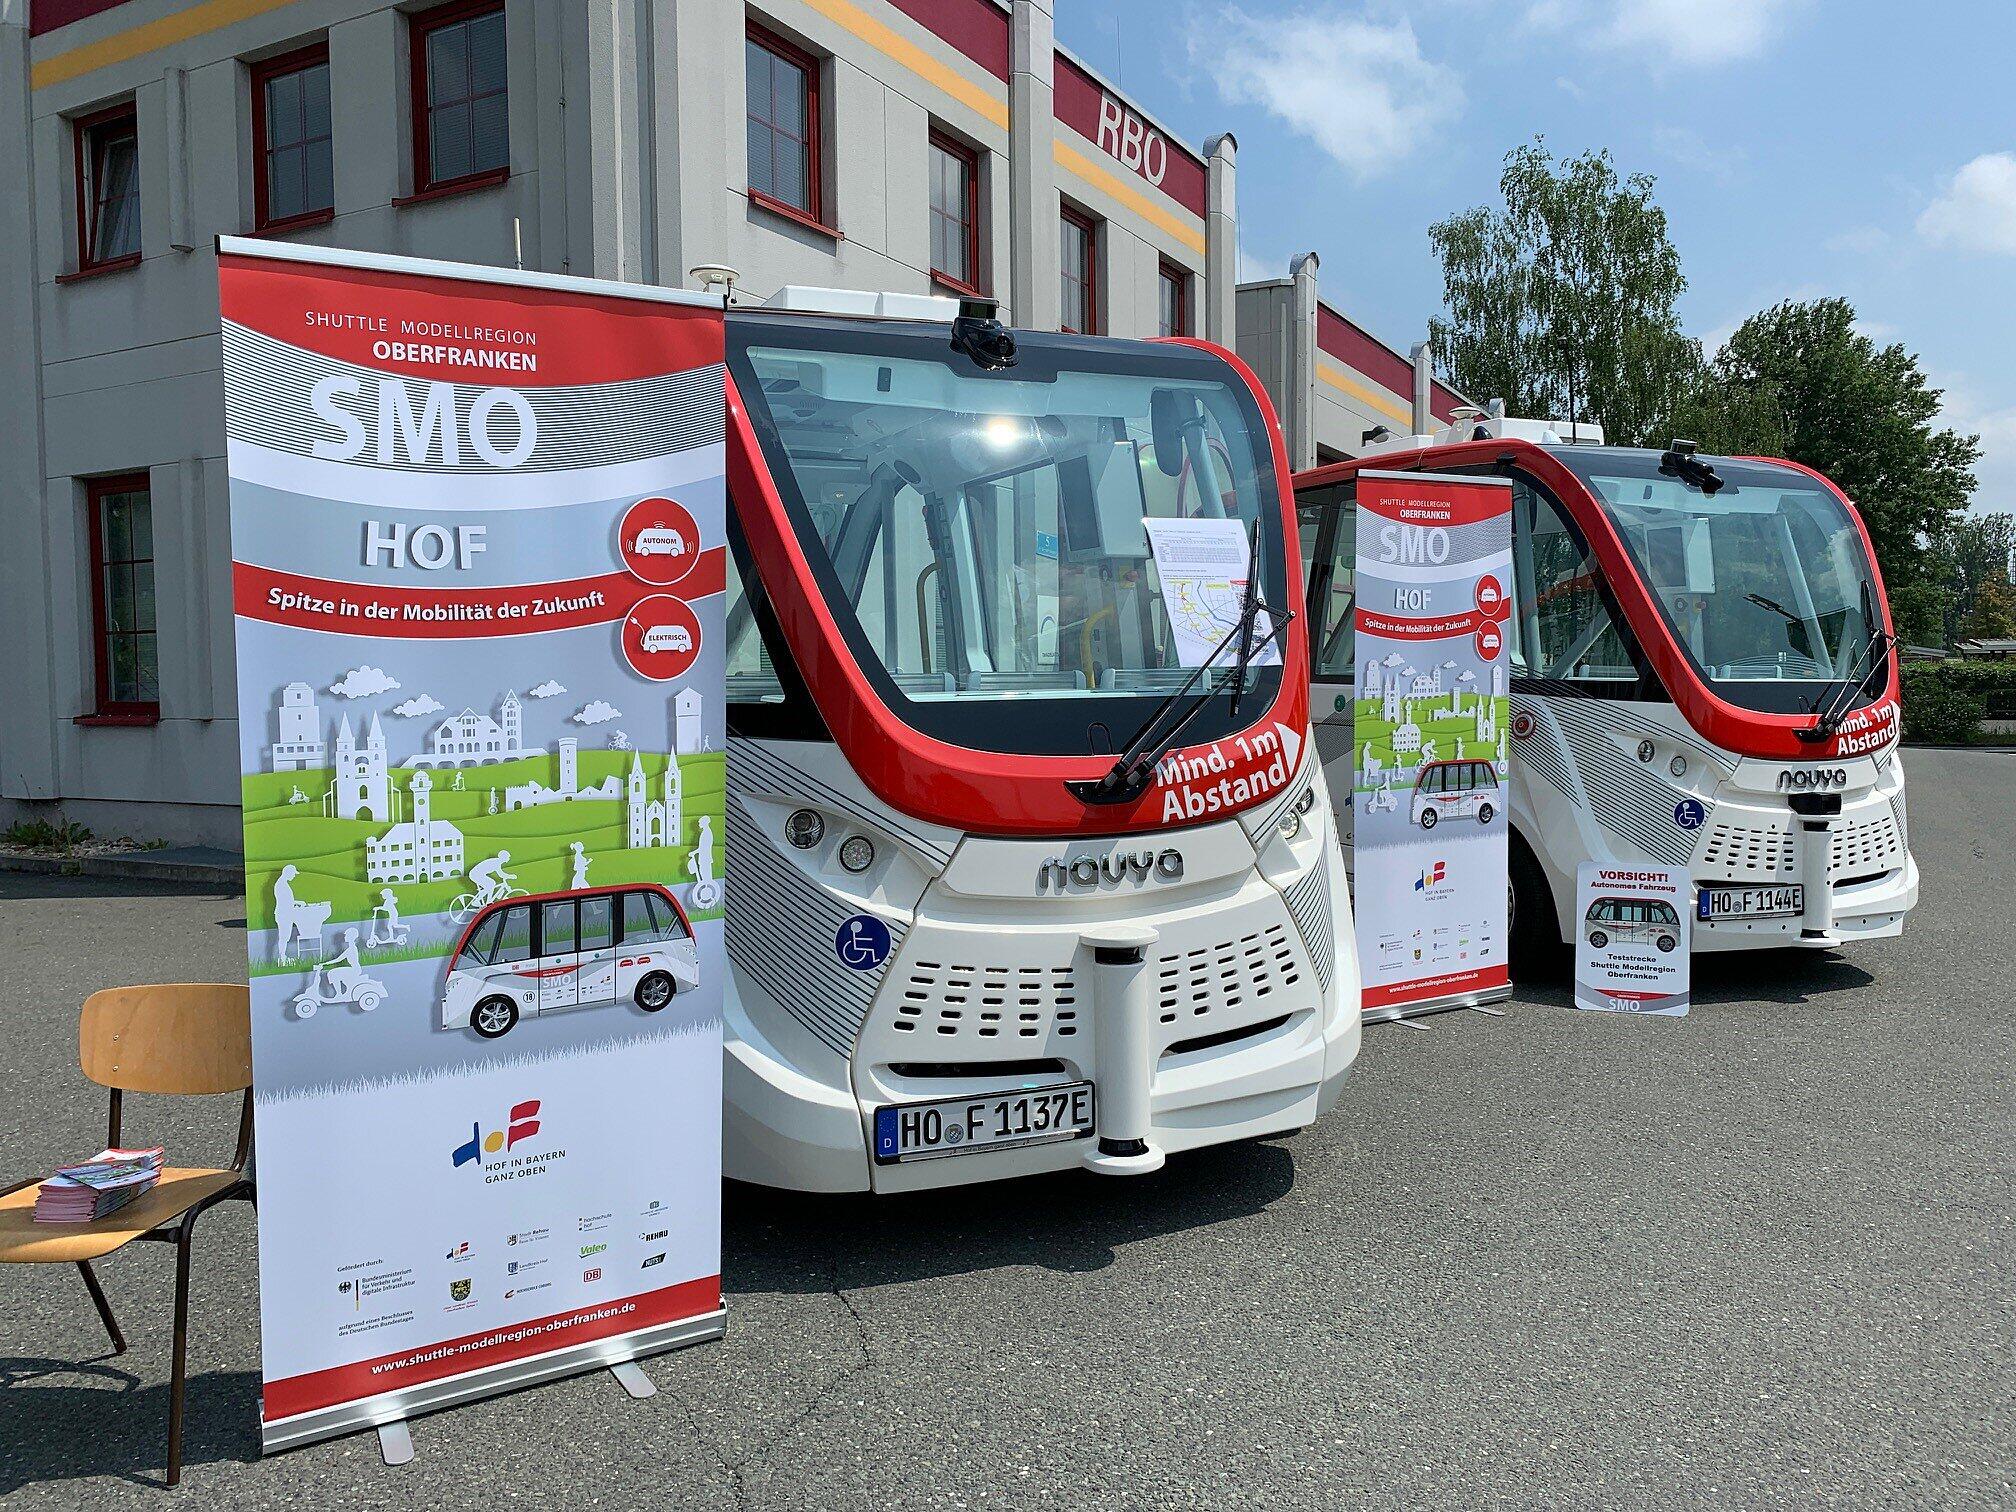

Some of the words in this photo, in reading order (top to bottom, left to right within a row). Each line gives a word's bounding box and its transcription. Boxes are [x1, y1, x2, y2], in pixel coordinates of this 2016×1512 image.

[1096, 89, 1166, 187] RBO
[305, 311, 388, 332] SHUTTLE
[401, 320, 537, 346] MODELLREGION
[372, 340, 537, 372] OBERFRANKEN
[310, 375, 538, 468] SMO
[1380, 498, 1405, 506] SHUTTLE
[1408, 500, 1451, 508] MODELLREGION
[1400, 509, 1451, 519] OBERFRANKEN
[364, 520, 487, 570] HOF
[642, 537, 677, 545] AUTONOM
[1380, 525, 1450, 564] SMO
[268, 587, 335, 614] Spitze
[339, 598, 359, 617] in
[364, 600, 399, 620] der
[403, 603, 494, 622] Mobilität
[497, 602, 528, 618] der
[532, 591, 605, 616] Zukunft
[1395, 588, 1432, 610] HOF
[1365, 618, 1386, 630] Spitze
[1387, 622, 1394, 631] in
[1395, 623, 1405, 632] der
[1406, 624, 1433, 633] Mobilität
[1433, 623, 1444, 632] der
[1445, 619, 1471, 630] Zukunft
[648, 634, 687, 642] ELEKTRISCH
[1871, 705, 1892, 722] 1m
[1837, 717, 1895, 756] Abstand
[1155, 745, 1235, 788] Mind.
[1235, 729, 1279, 764] 1m
[1161, 752, 1286, 823] Abstand
[1599, 870, 1669, 882] VORSICHT!
[1590, 881, 1636, 890] Autonomes
[1638, 884, 1676, 893] Fahrzeug
[1711, 892, 1732, 913] HO
[1743, 892, 1752, 912] F
[1756, 888, 1801, 911] 1144E
[1607, 954, 1657, 963] Teststrecke
[1590, 961, 1620, 969] Shuttle
[1622, 963, 1676, 974] Modellregion
[543, 974, 572, 988] SMO
[1607, 972, 1658, 981] Oberfranken
[1609, 998, 1640, 1012] SMO
[901, 1108, 942, 1148] HO
[967, 1104, 986, 1140] F
[994, 1090, 1090, 1137] 1137E
[884, 1138, 892, 1148] D
[485, 1161, 507, 1172] HOF
[511, 1158, 522, 1168] IN
[526, 1150, 566, 1164] BAYERN
[485, 1172, 515, 1184] GANZ
[518, 1166, 546, 1178] OBEN
[646, 1230, 668, 1242] REHAU
[580, 1243, 607, 1255] Valeo
[586, 1270, 599, 1281] DB
[371, 1302, 636, 1375] www.shuttle-modellregion-oberfranken.de
